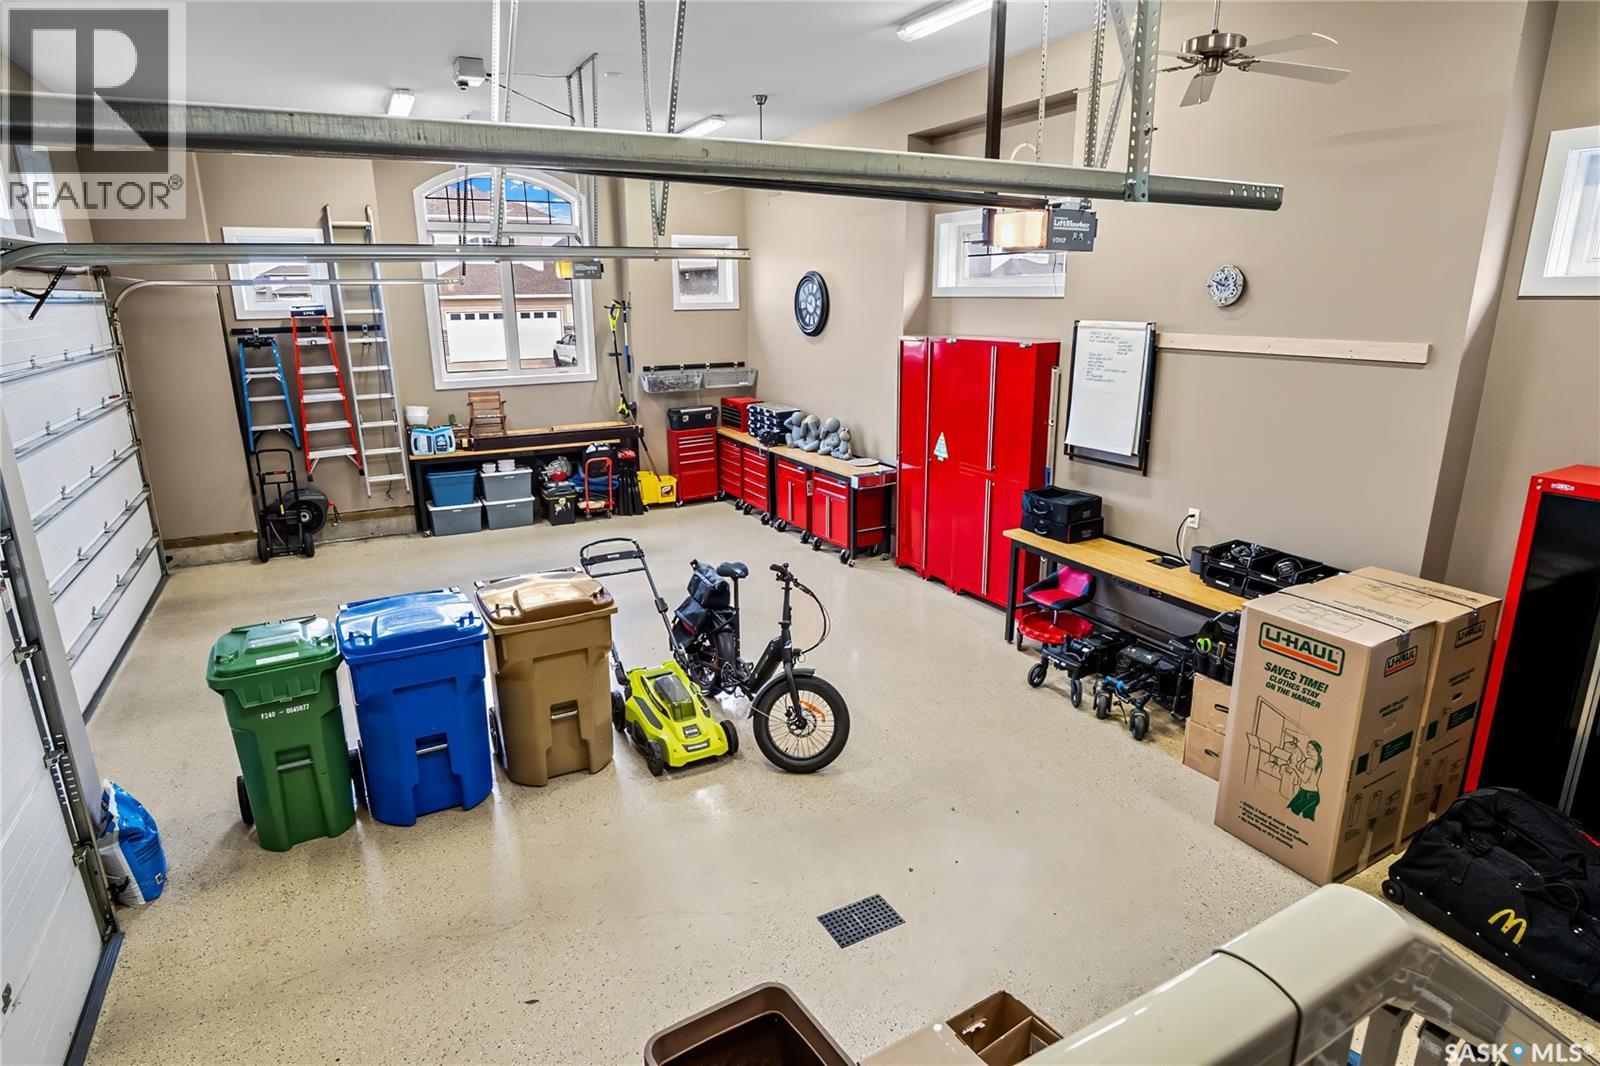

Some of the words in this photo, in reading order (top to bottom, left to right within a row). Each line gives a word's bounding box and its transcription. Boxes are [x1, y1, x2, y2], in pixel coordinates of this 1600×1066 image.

[1264, 626, 1340, 664] U-HAUL
[1386, 648, 1416, 669] U-HAUL
[1264, 661, 1297, 681] SAVES
[1299, 672, 1329, 694] TIME!
[1269, 674, 1301, 692] CLOTHES
[1301, 686, 1320, 699] STAY
[1265, 681, 1276, 690] ON
[1277, 686, 1290, 698] THE
[1291, 692, 1321, 709] HANGER
